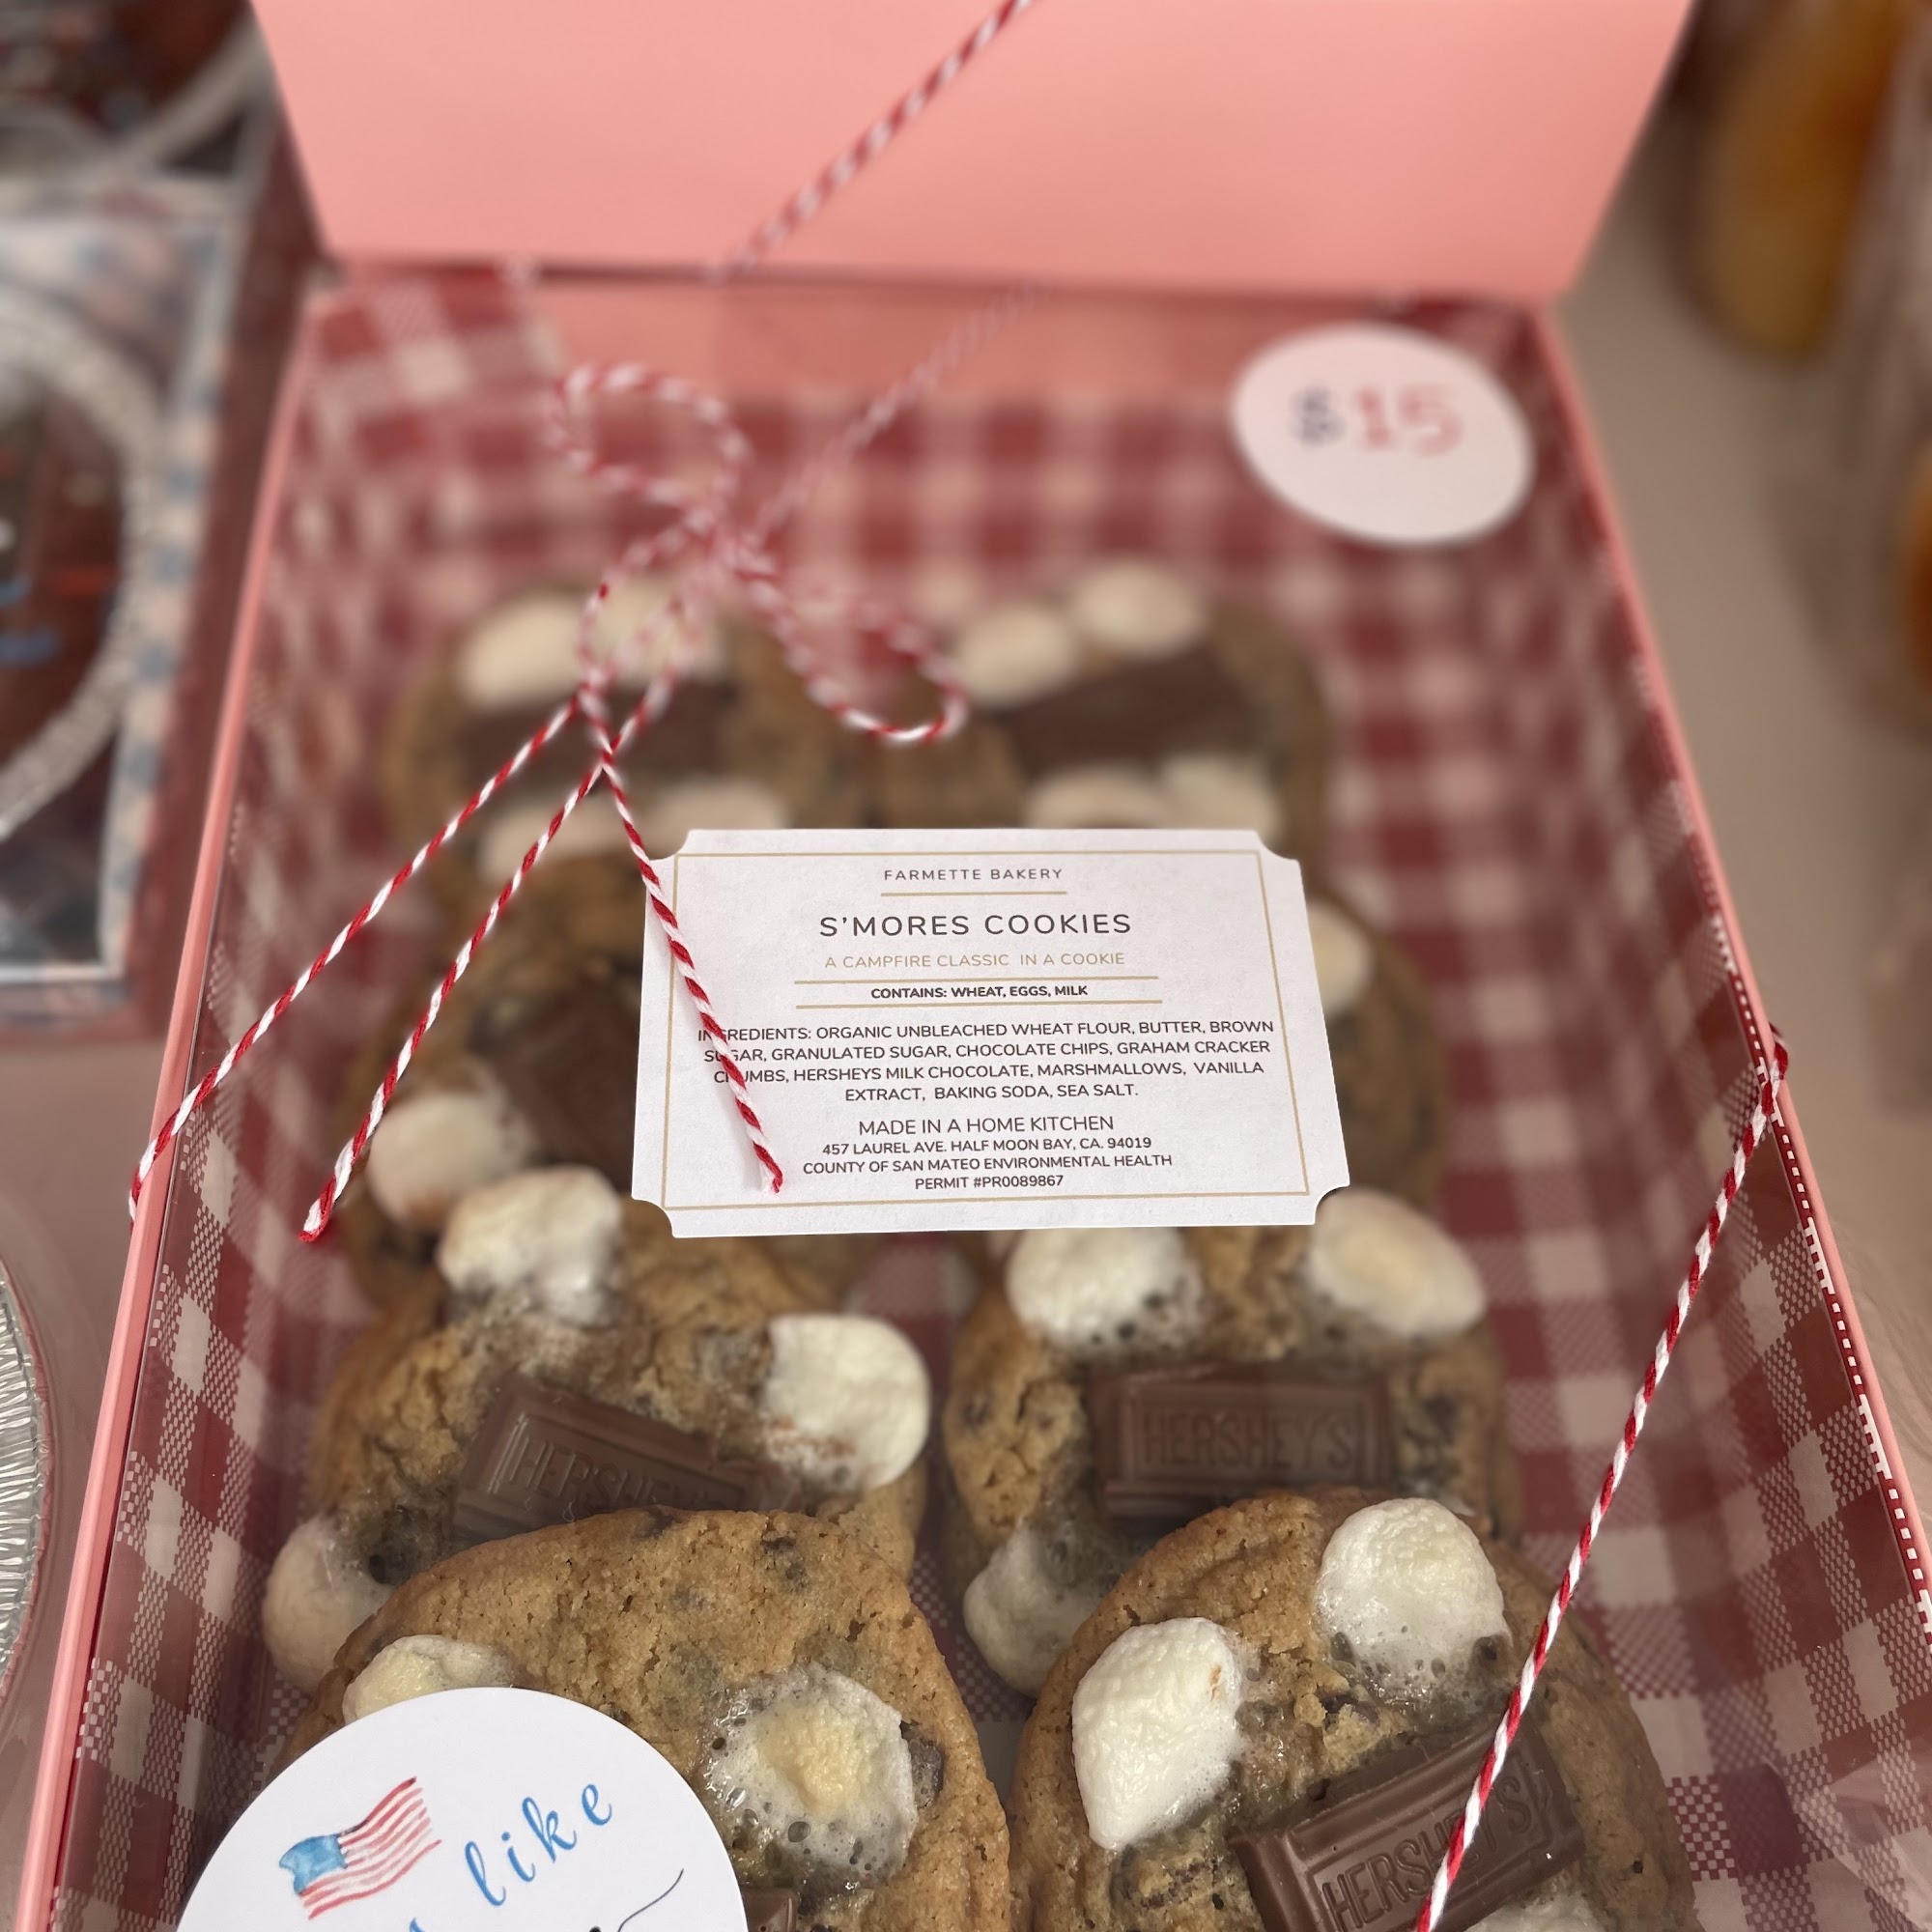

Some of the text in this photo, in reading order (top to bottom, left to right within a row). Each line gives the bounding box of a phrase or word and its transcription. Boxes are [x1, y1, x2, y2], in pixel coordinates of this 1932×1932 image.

[1291, 381, 1465, 459] $15
[883, 867, 1064, 881] FARMETTE BAKERY
[983, 913, 1132, 935] COOKIES
[824, 952, 1125, 969] A CAMPFIRE CLASSIC IN A COOKIE
[870, 984, 1089, 1000] CONTAINS: WHEAT, EGGS, MILK
[698, 1020, 1274, 1042] INREDIENTS: ORGANIC UNBLEACHED WHEAT FLOUR, BUTTER, BROWN
[771, 1046, 886, 1062] GRANULATED
[889, 1044, 952, 1059] SUGAR,
[955, 1042, 1057, 1058] CHOCOLATE
[1060, 1041, 1114, 1057] CHIPS,
[1116, 1040, 1191, 1055] GRAHAM
[1193, 1039, 1271, 1054] CRACKER
[793, 1066, 882, 1082] HERSHEYS
[885, 1066, 925, 1080] MILK
[927, 1064, 1034, 1079] CHOCOLATE,
[1037, 1062, 1187, 1077] MARSHMALLOWS,
[1192, 1061, 1264, 1075] VANILLA
[844, 1083, 1139, 1102] EXTRACT, BAKING SODA, SEA SALT.
[859, 1115, 1115, 1136] MADE IN A HOME KITCHEN
[821, 1137, 1152, 1156] 457 LAUREL AVE. HALF MOON BAY, CA. 94019
[802, 1153, 1173, 1175] COUNTY OF SAN MATEO ENVIRONMENTAL HEALTH
[914, 1174, 1065, 1190] PERMIT #PR0089867
[464, 1783, 612, 1907] like
[1321, 1775, 1533, 1932] HERSHS
